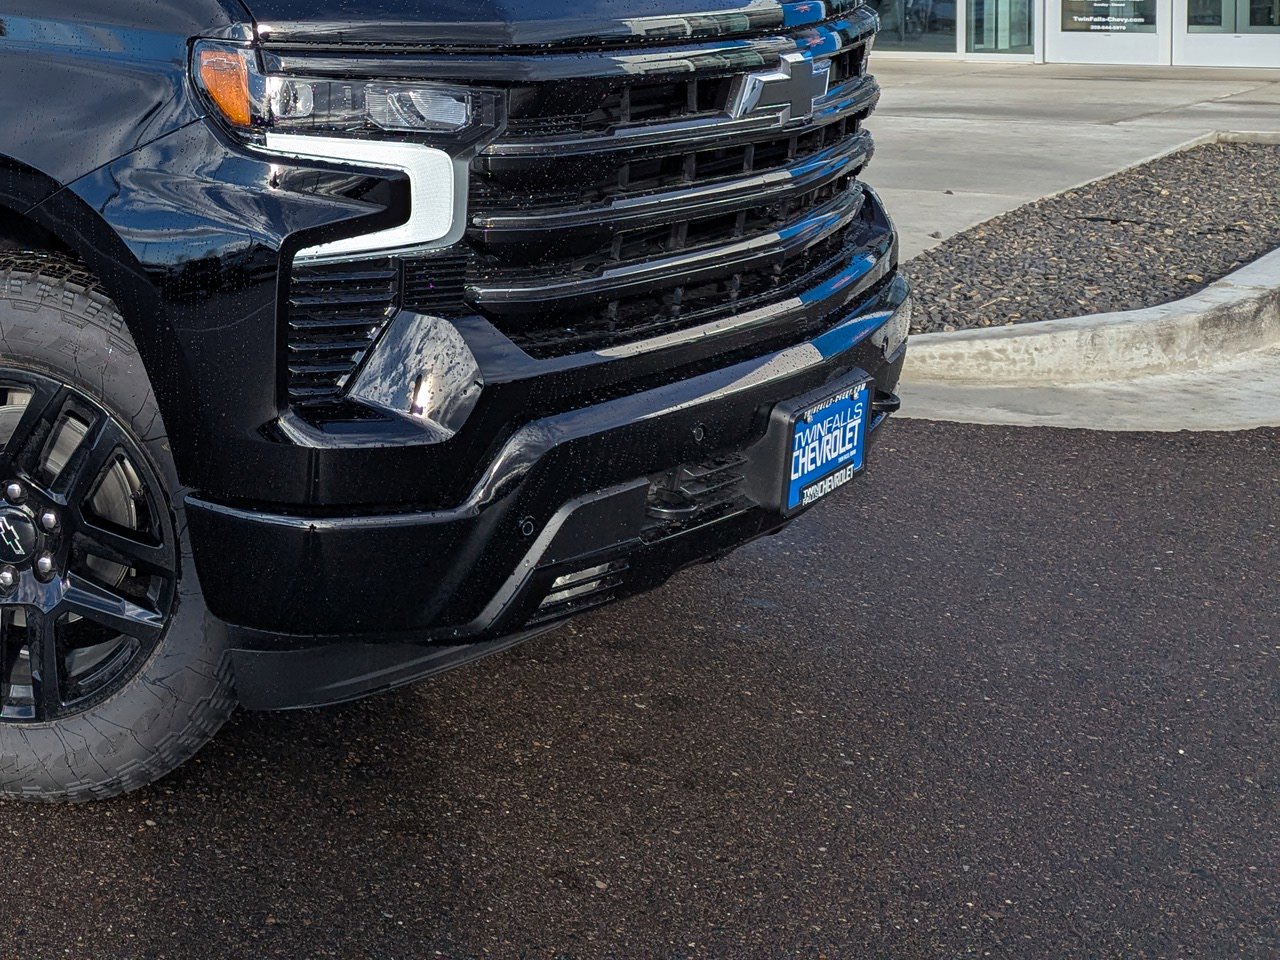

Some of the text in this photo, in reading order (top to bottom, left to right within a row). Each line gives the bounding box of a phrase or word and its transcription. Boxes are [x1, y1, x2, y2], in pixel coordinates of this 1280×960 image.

[794, 402, 863, 451] TWINFALLS
[790, 418, 862, 481] CHEVROLET
[802, 483, 821, 499] TWIN
[819, 463, 855, 497] CHEVROLET
